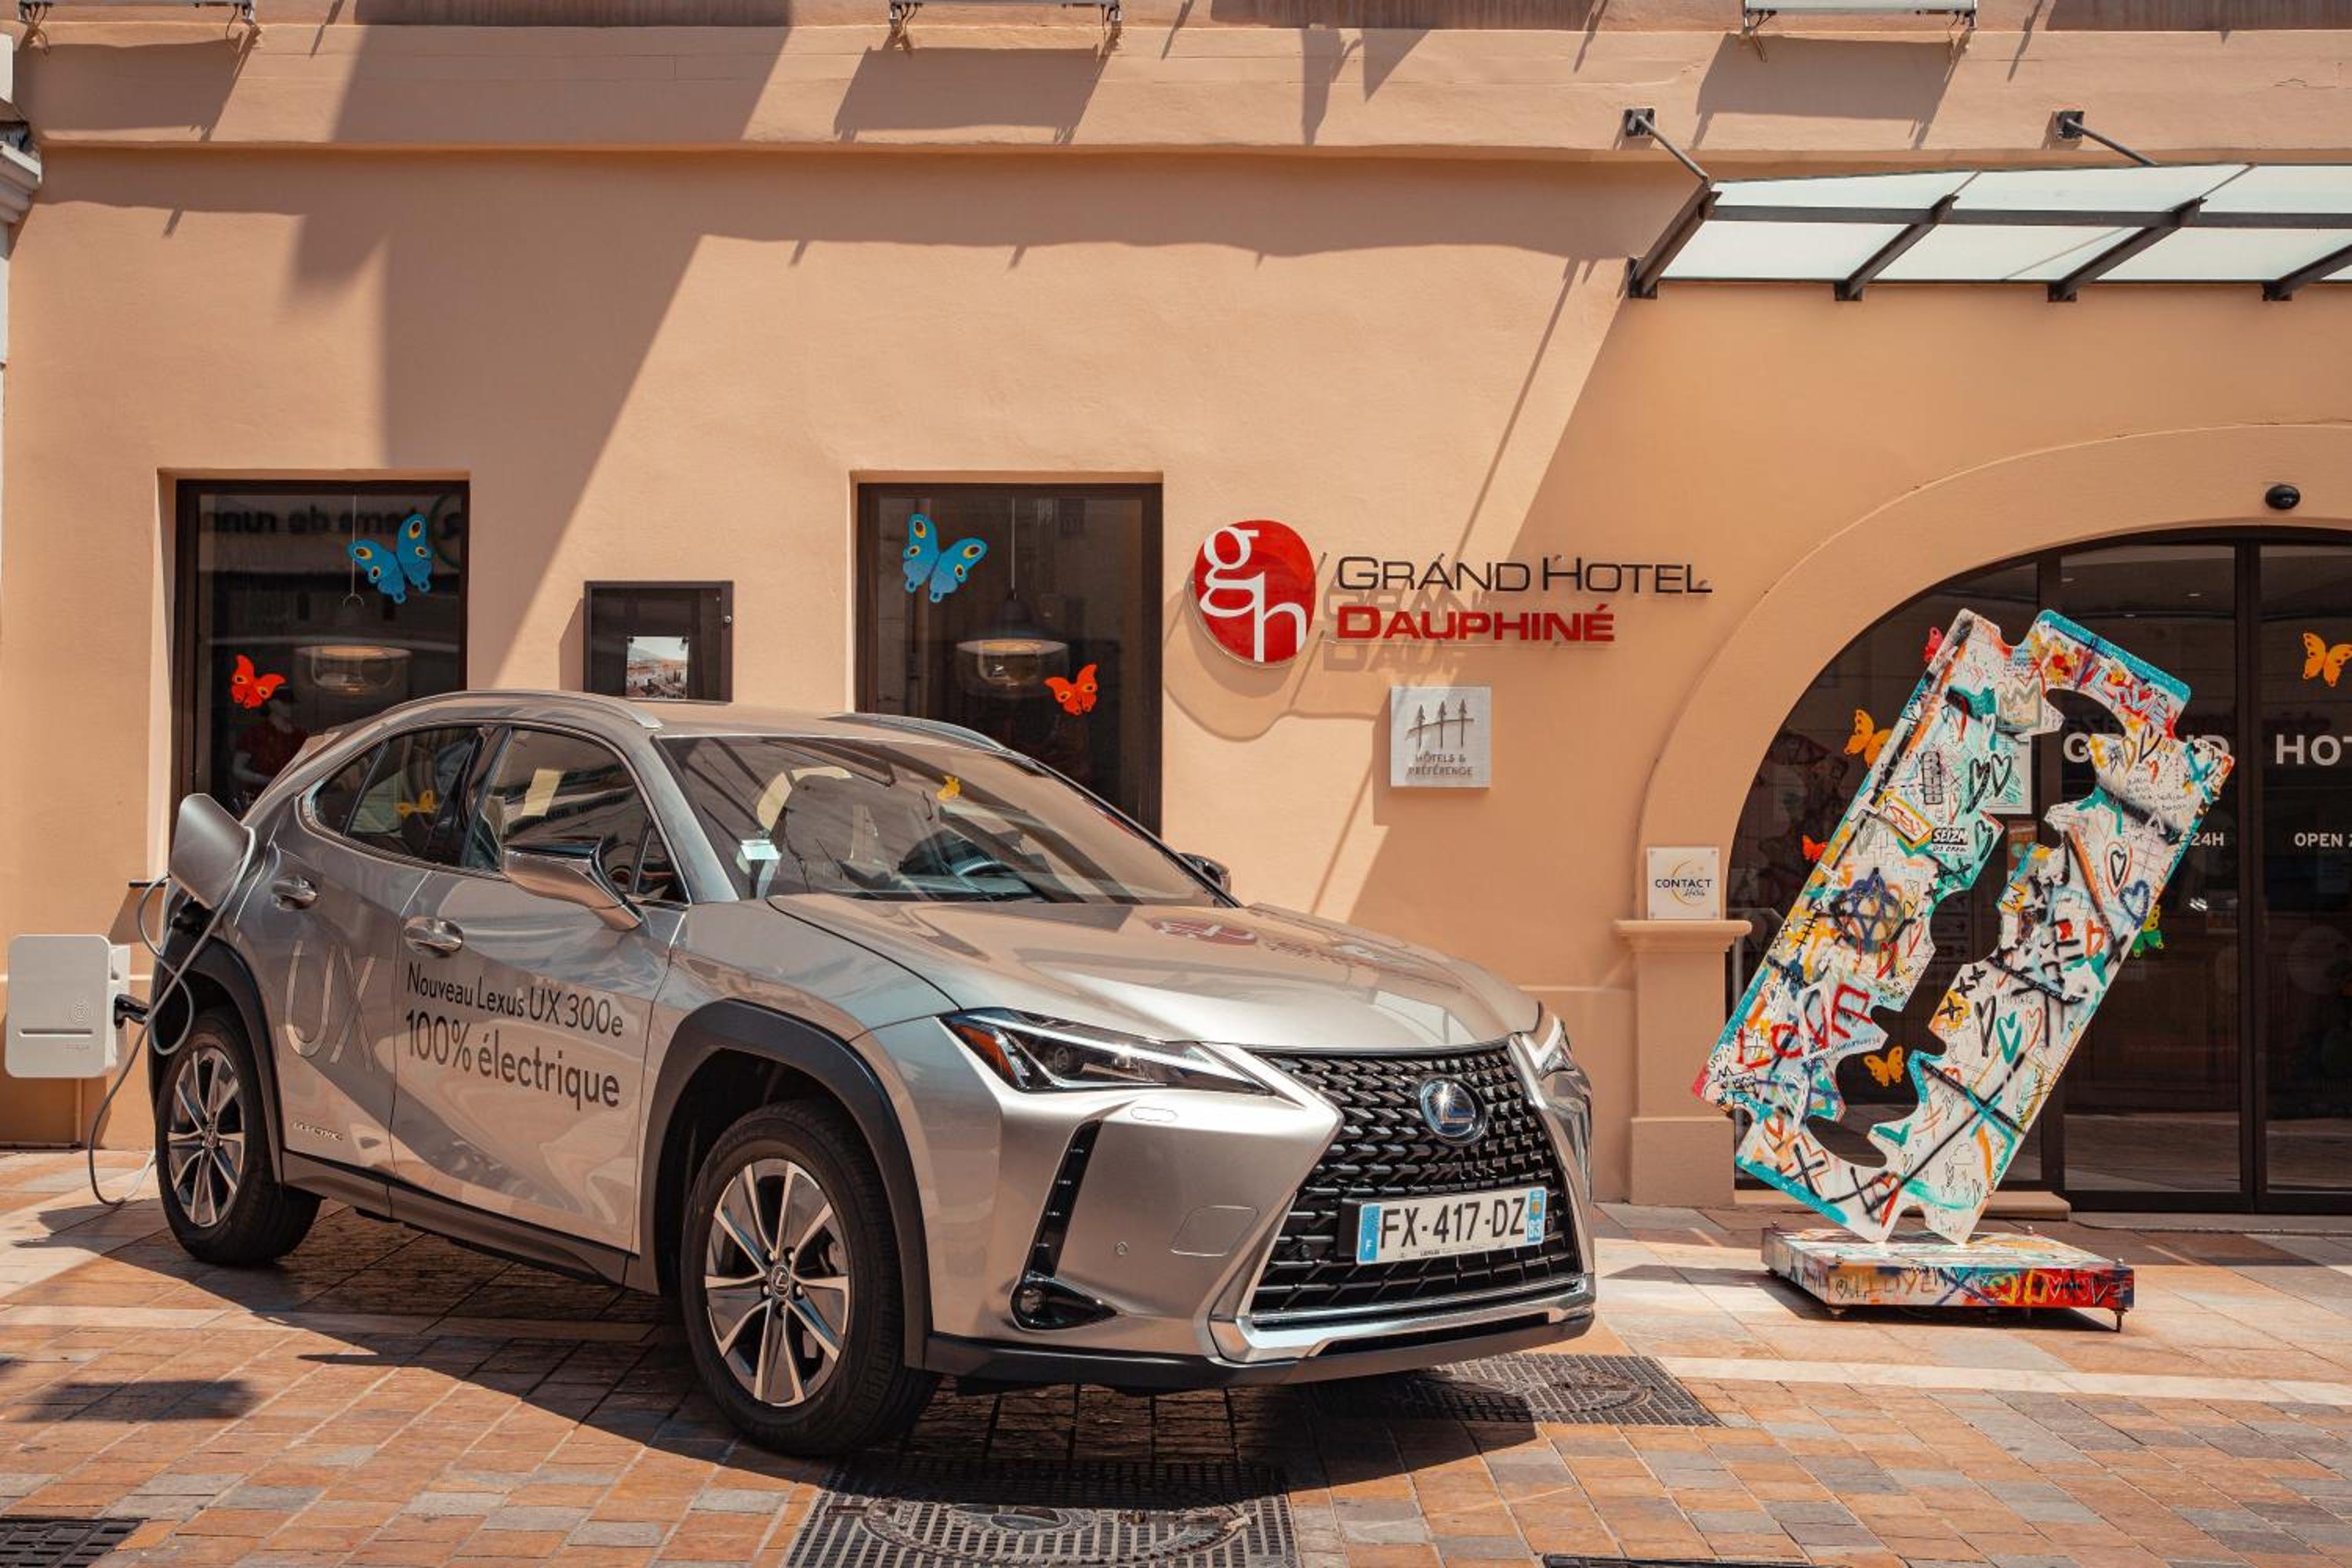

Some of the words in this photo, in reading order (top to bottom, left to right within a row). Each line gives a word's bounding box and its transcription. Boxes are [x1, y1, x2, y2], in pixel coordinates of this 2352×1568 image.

[1338, 555, 1530, 592] GRAND
[1542, 557, 1713, 594] HOTEL
[1200, 526, 1307, 662] gh
[1337, 604, 1615, 642] DAUPHINÉ
[1416, 750, 1455, 763] HÔTELS
[2276, 733, 2352, 766] HO
[1407, 764, 1473, 775] PRÉFÉRENCE
[2294, 832, 2343, 847] OPEN
[1655, 879, 1712, 888] CONTACT
[285, 940, 376, 1073] UX
[407, 961, 474, 1007] Nouveau
[478, 975, 524, 1018] Lexus
[529, 985, 562, 1025] UX
[564, 993, 624, 1037] 300e
[405, 1008, 472, 1073] 100%
[477, 1029, 621, 1111] électrique
